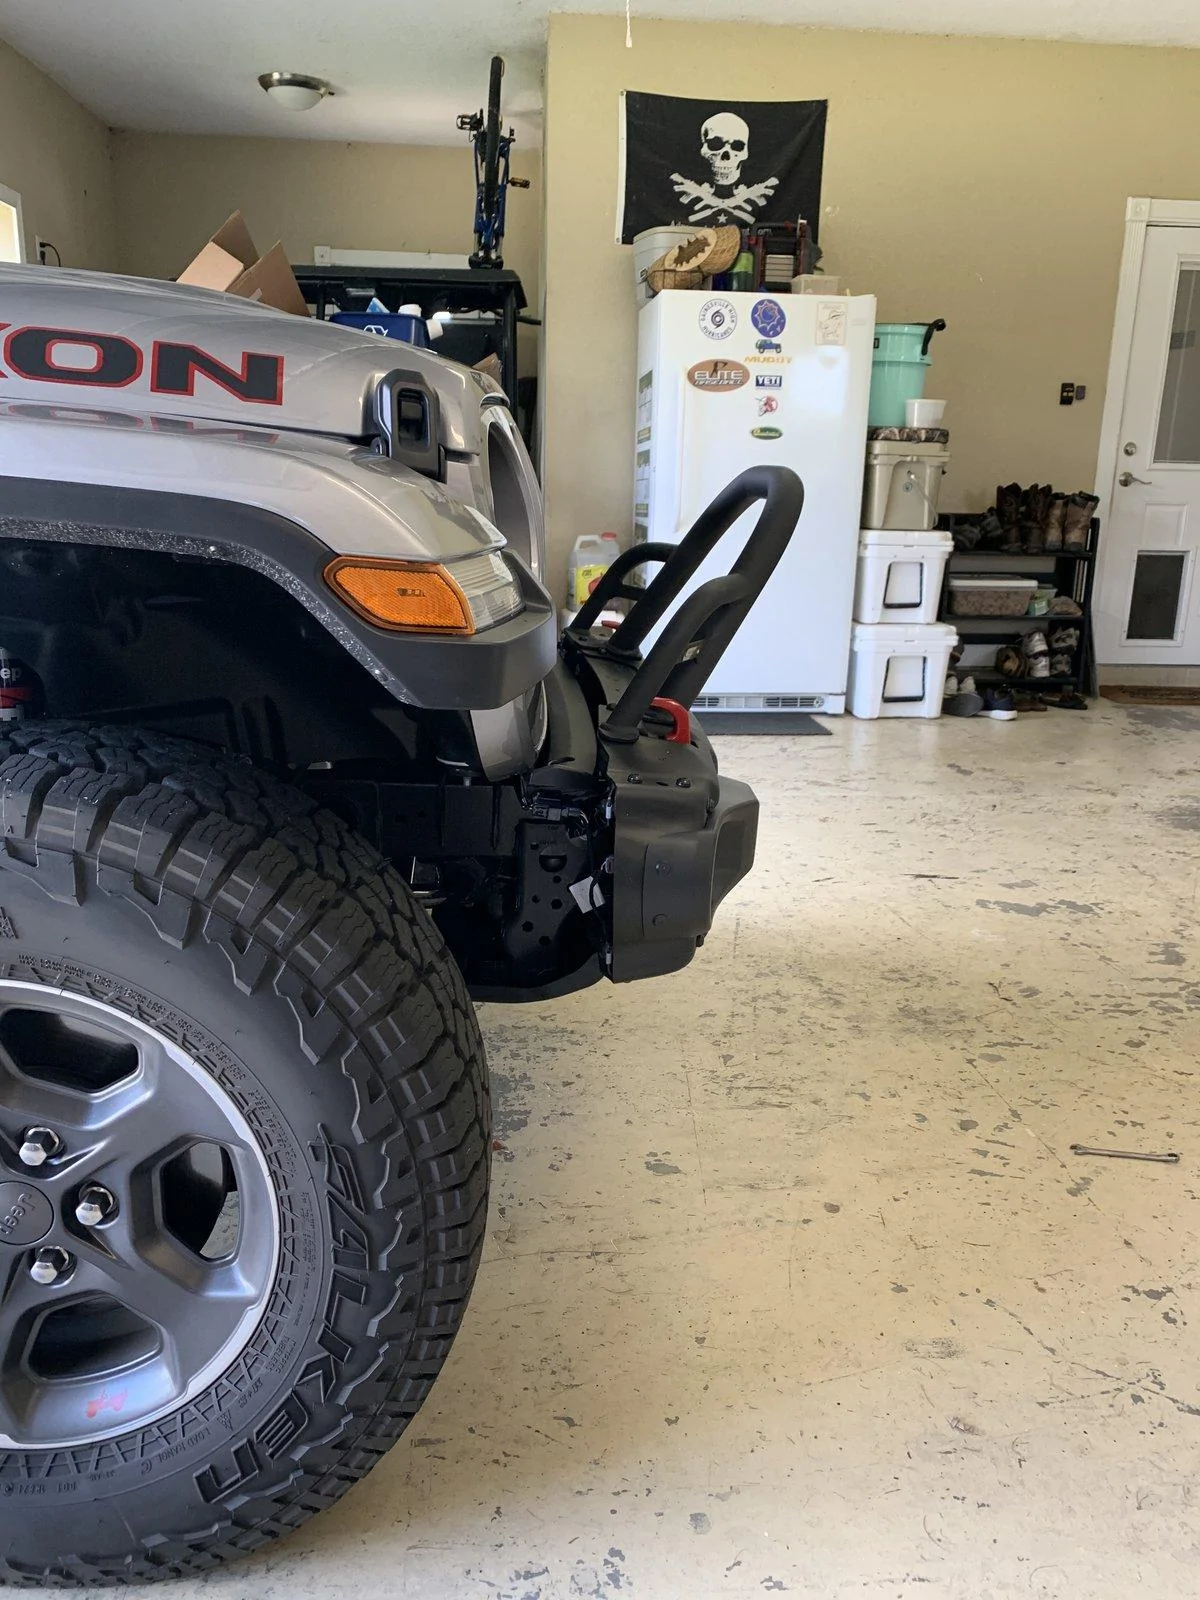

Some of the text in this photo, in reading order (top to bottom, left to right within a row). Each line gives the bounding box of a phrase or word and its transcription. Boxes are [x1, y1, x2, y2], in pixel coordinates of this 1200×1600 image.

[0, 323, 284, 406] ON
[694, 370, 743, 380] ELITE
[757, 376, 780, 386] YETI
